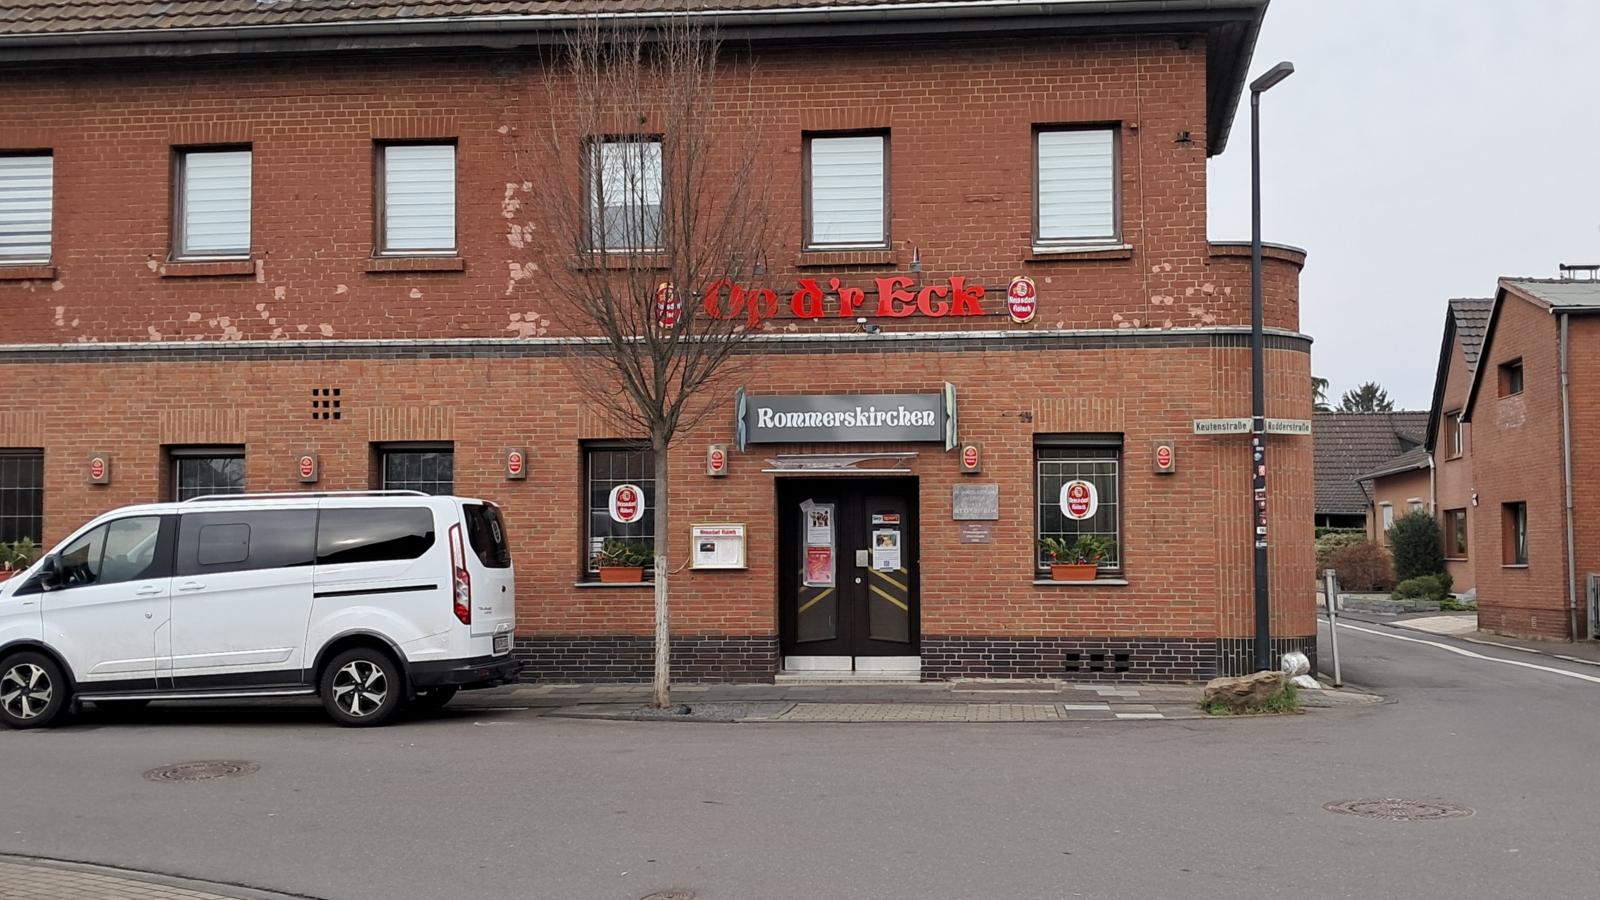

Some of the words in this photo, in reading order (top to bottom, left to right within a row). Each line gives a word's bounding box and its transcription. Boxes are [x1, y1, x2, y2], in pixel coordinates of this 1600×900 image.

[703, 276, 779, 329] Op
[791, 277, 865, 318] d'r
[874, 275, 985, 317] Eck
[757, 406, 936, 428] Rommerskirchen
[1196, 421, 1247, 431] Keutenstraße
